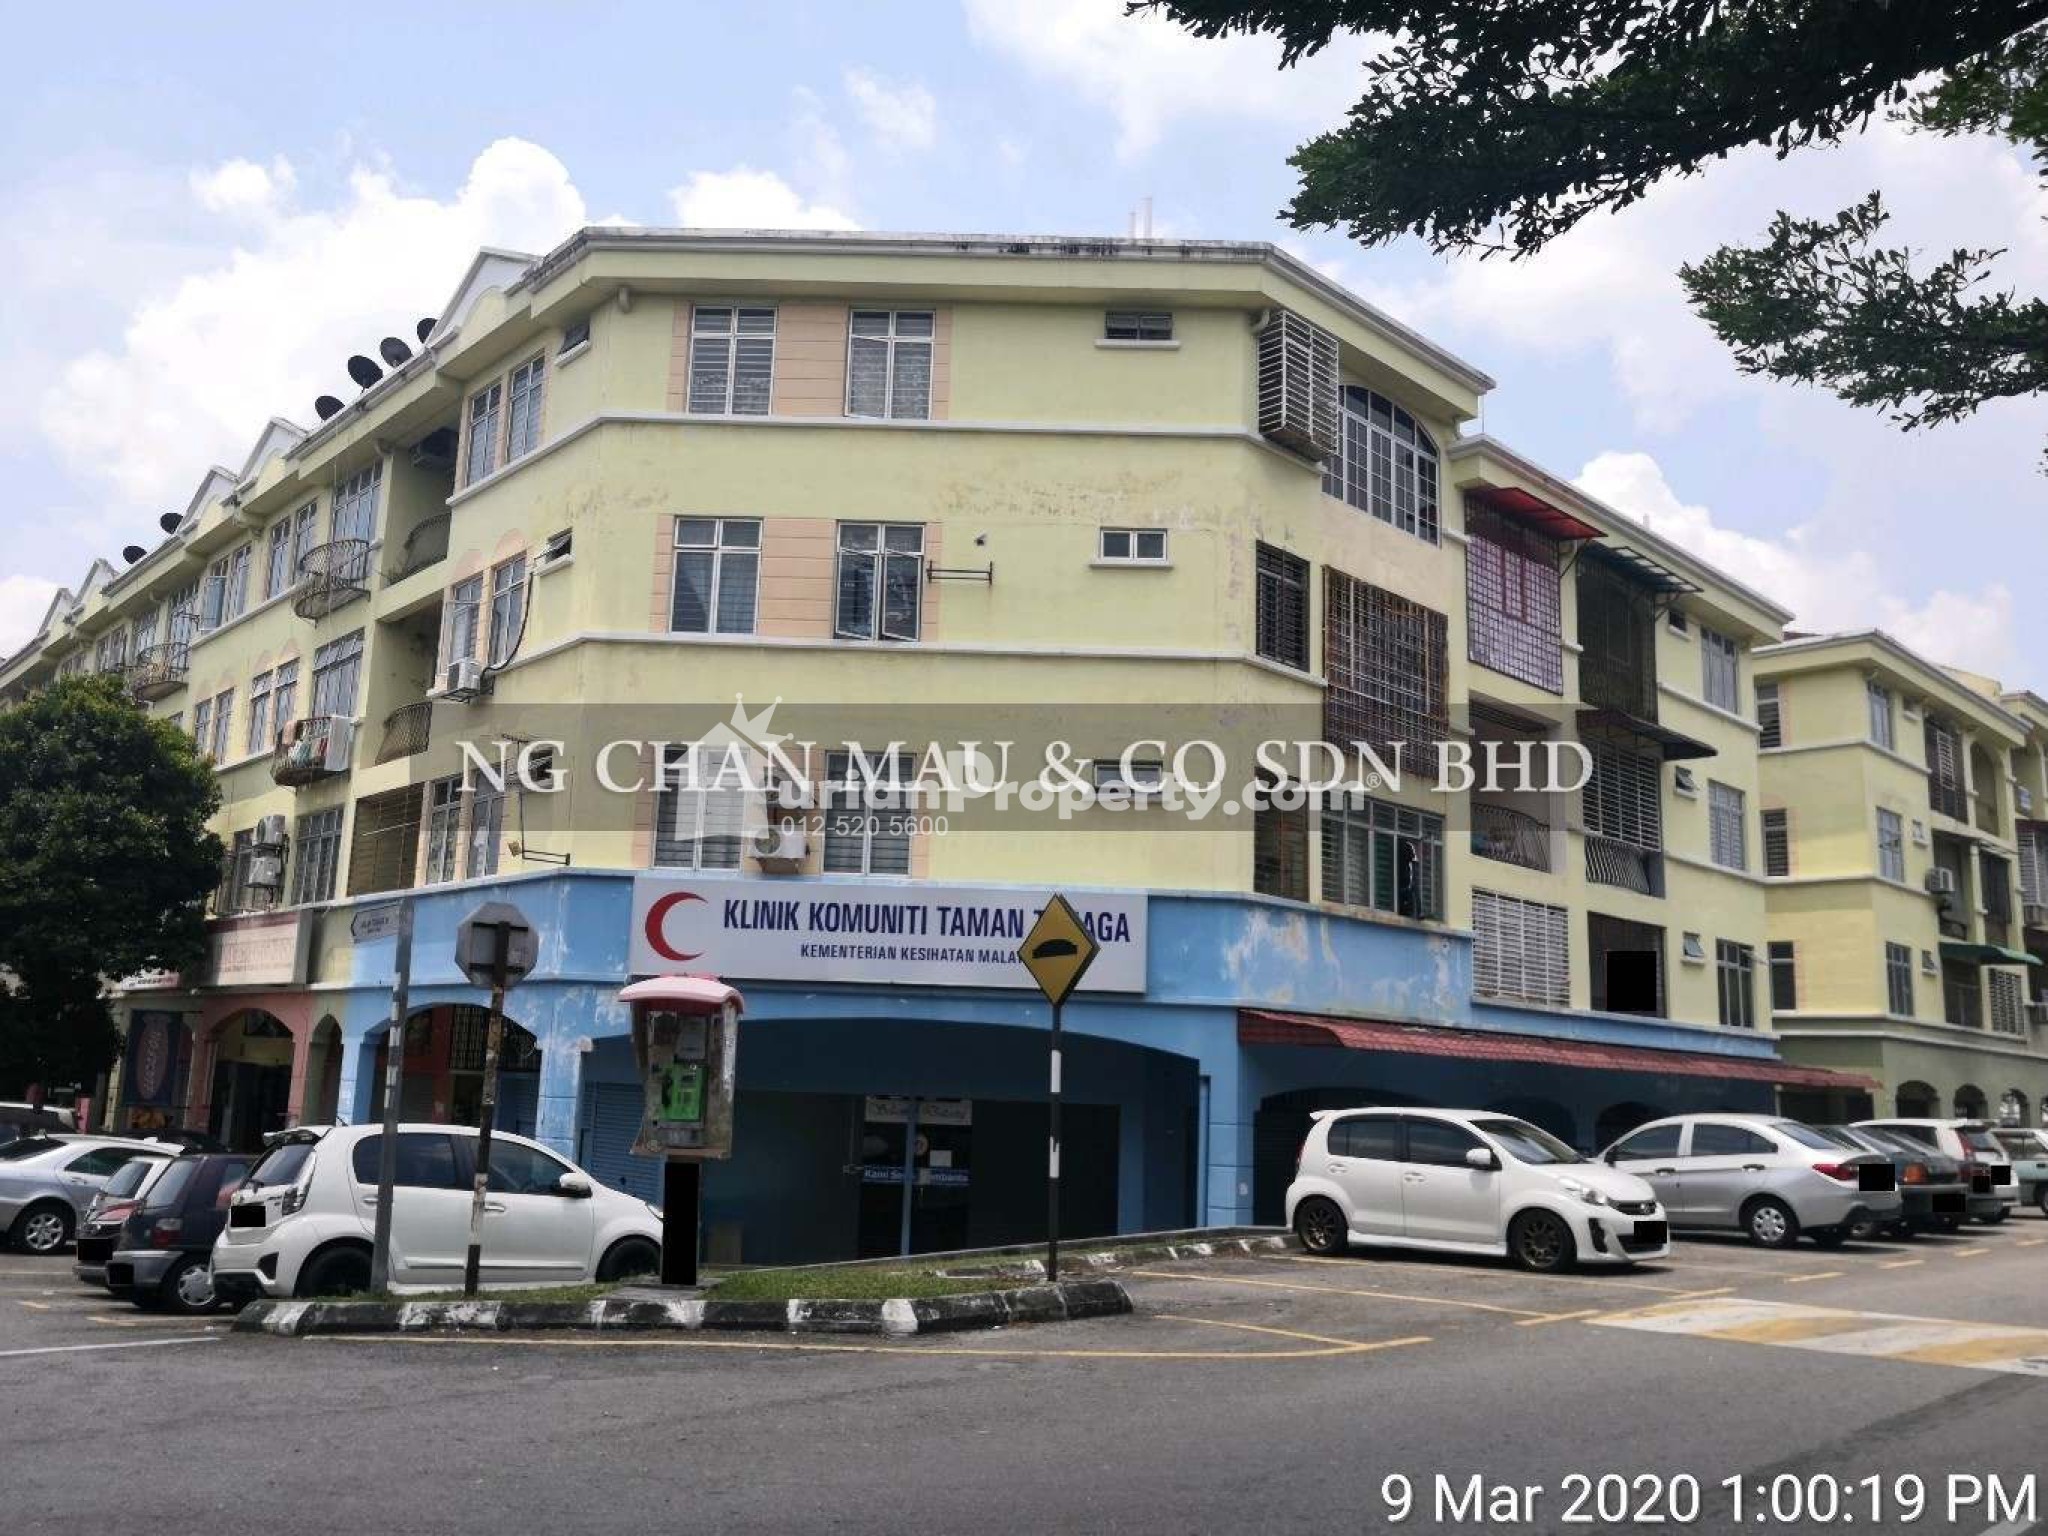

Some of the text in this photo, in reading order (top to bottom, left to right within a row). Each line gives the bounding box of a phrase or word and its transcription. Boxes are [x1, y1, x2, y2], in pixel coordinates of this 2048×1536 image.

[724, 900, 800, 931] KLINIK
[809, 902, 927, 935] KOMUNITI
[936, 906, 1024, 938] TAMAN
[801, 944, 896, 960] KEMENTERIAN
[901, 947, 975, 962] KESIHATAN
